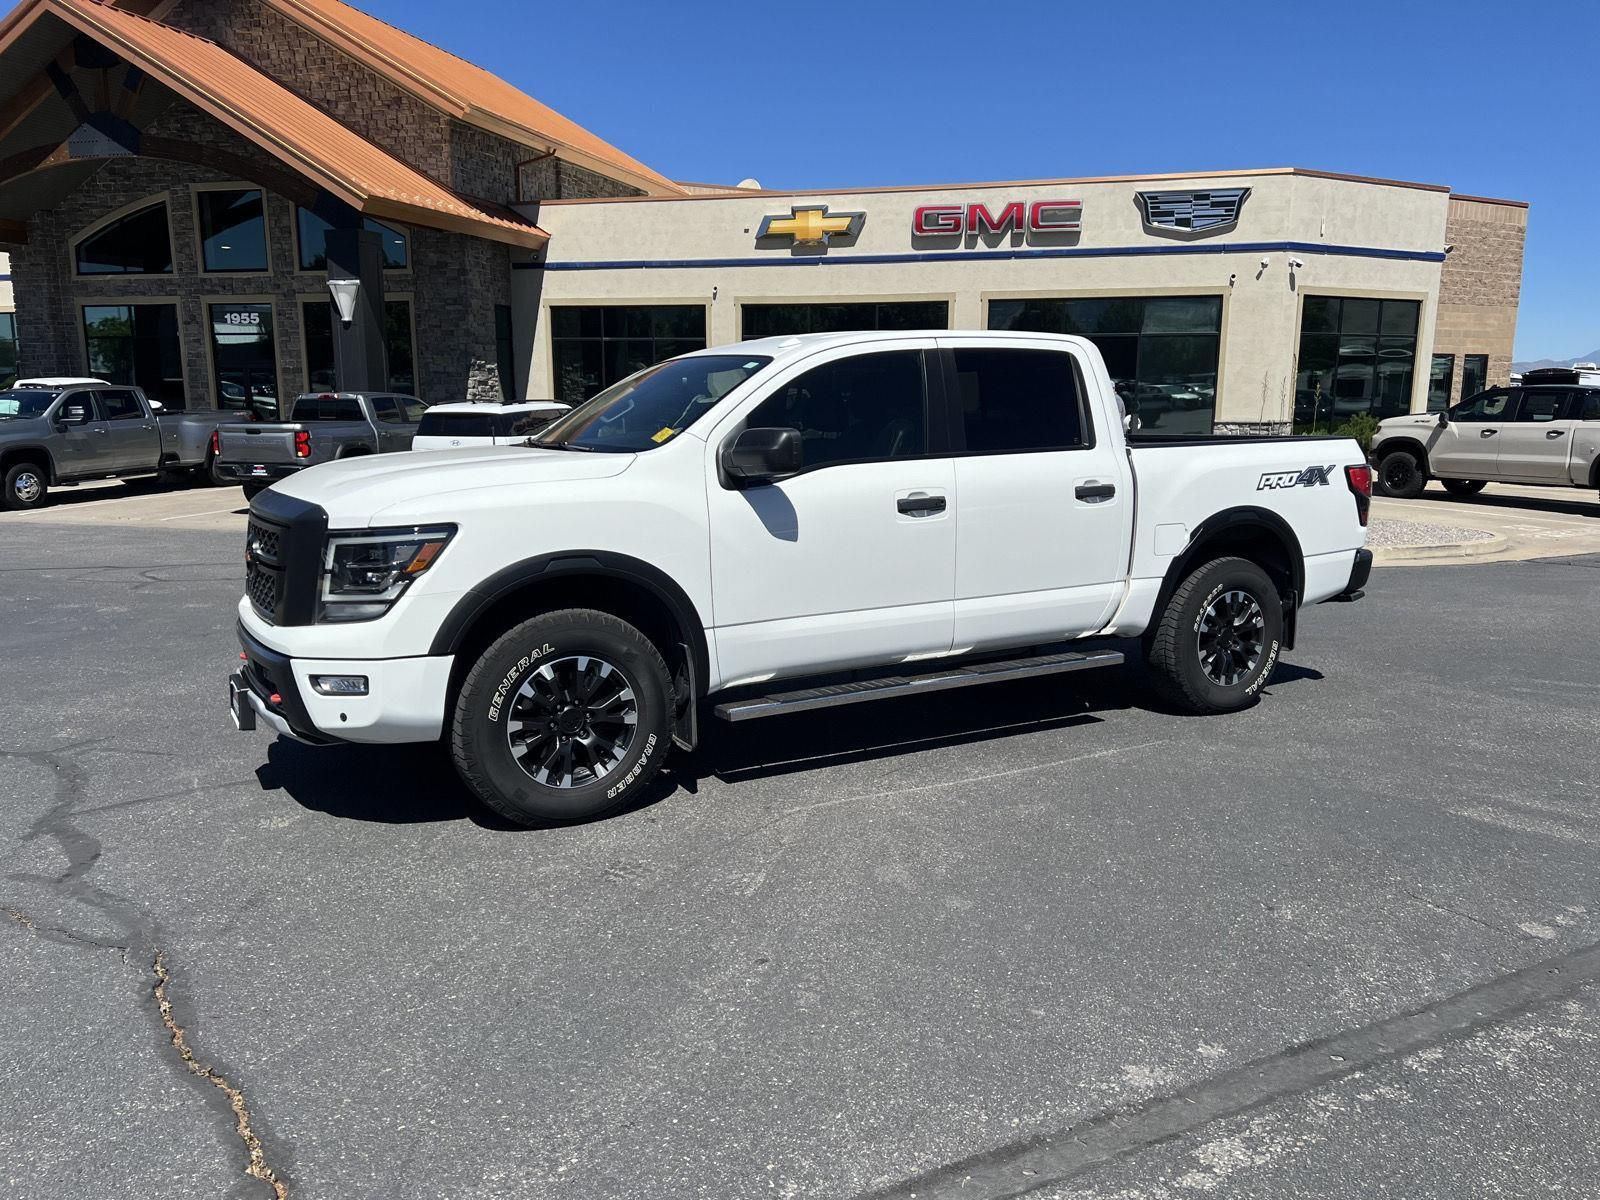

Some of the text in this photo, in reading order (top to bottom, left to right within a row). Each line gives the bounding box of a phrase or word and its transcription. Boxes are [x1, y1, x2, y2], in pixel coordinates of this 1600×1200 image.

[912, 200, 1083, 236] GMC
[224, 312, 260, 324] 1955
[488, 643, 555, 722] GENERAL
[607, 733, 657, 798] GRABBER
